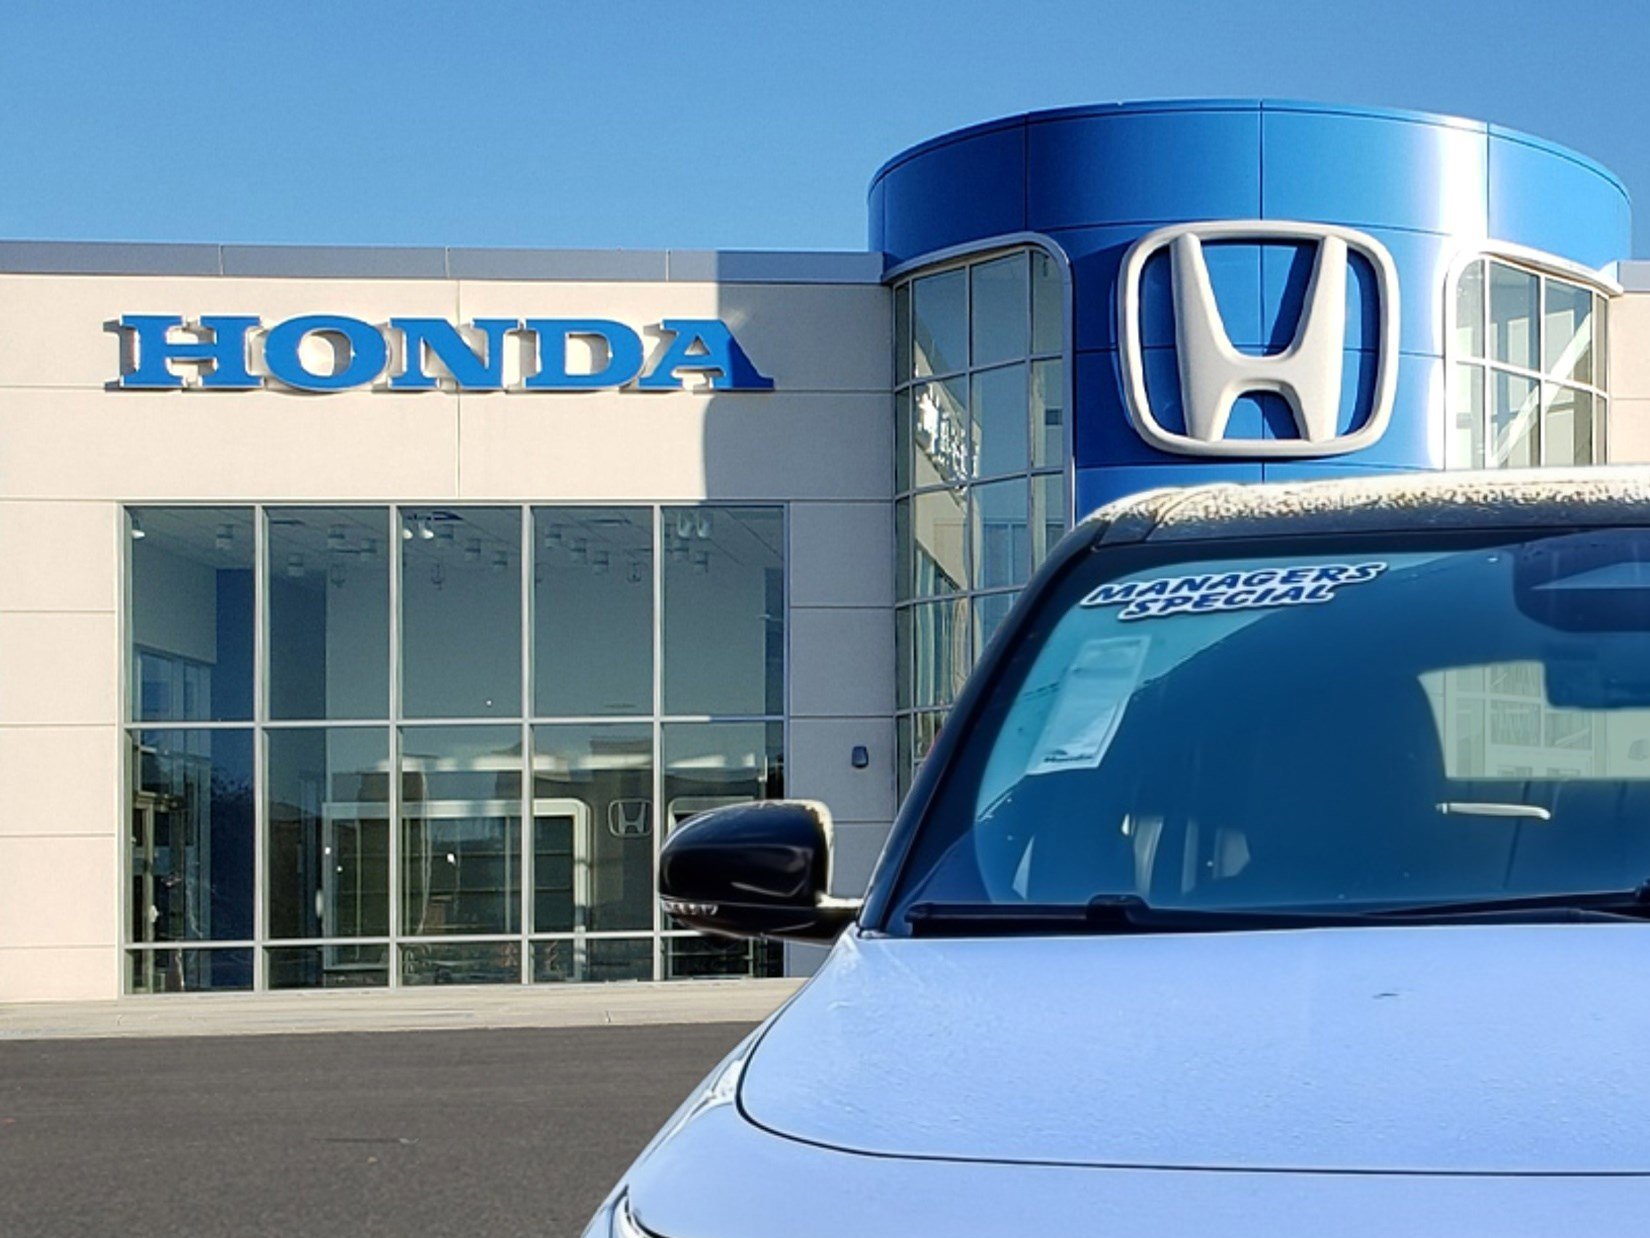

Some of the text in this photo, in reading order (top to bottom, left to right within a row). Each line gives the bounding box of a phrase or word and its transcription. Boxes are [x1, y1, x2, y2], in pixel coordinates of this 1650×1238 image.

[121, 314, 776, 392] HONDA
[1084, 563, 1385, 604] MANAGERS
[1122, 583, 1333, 617] SPECIAL
